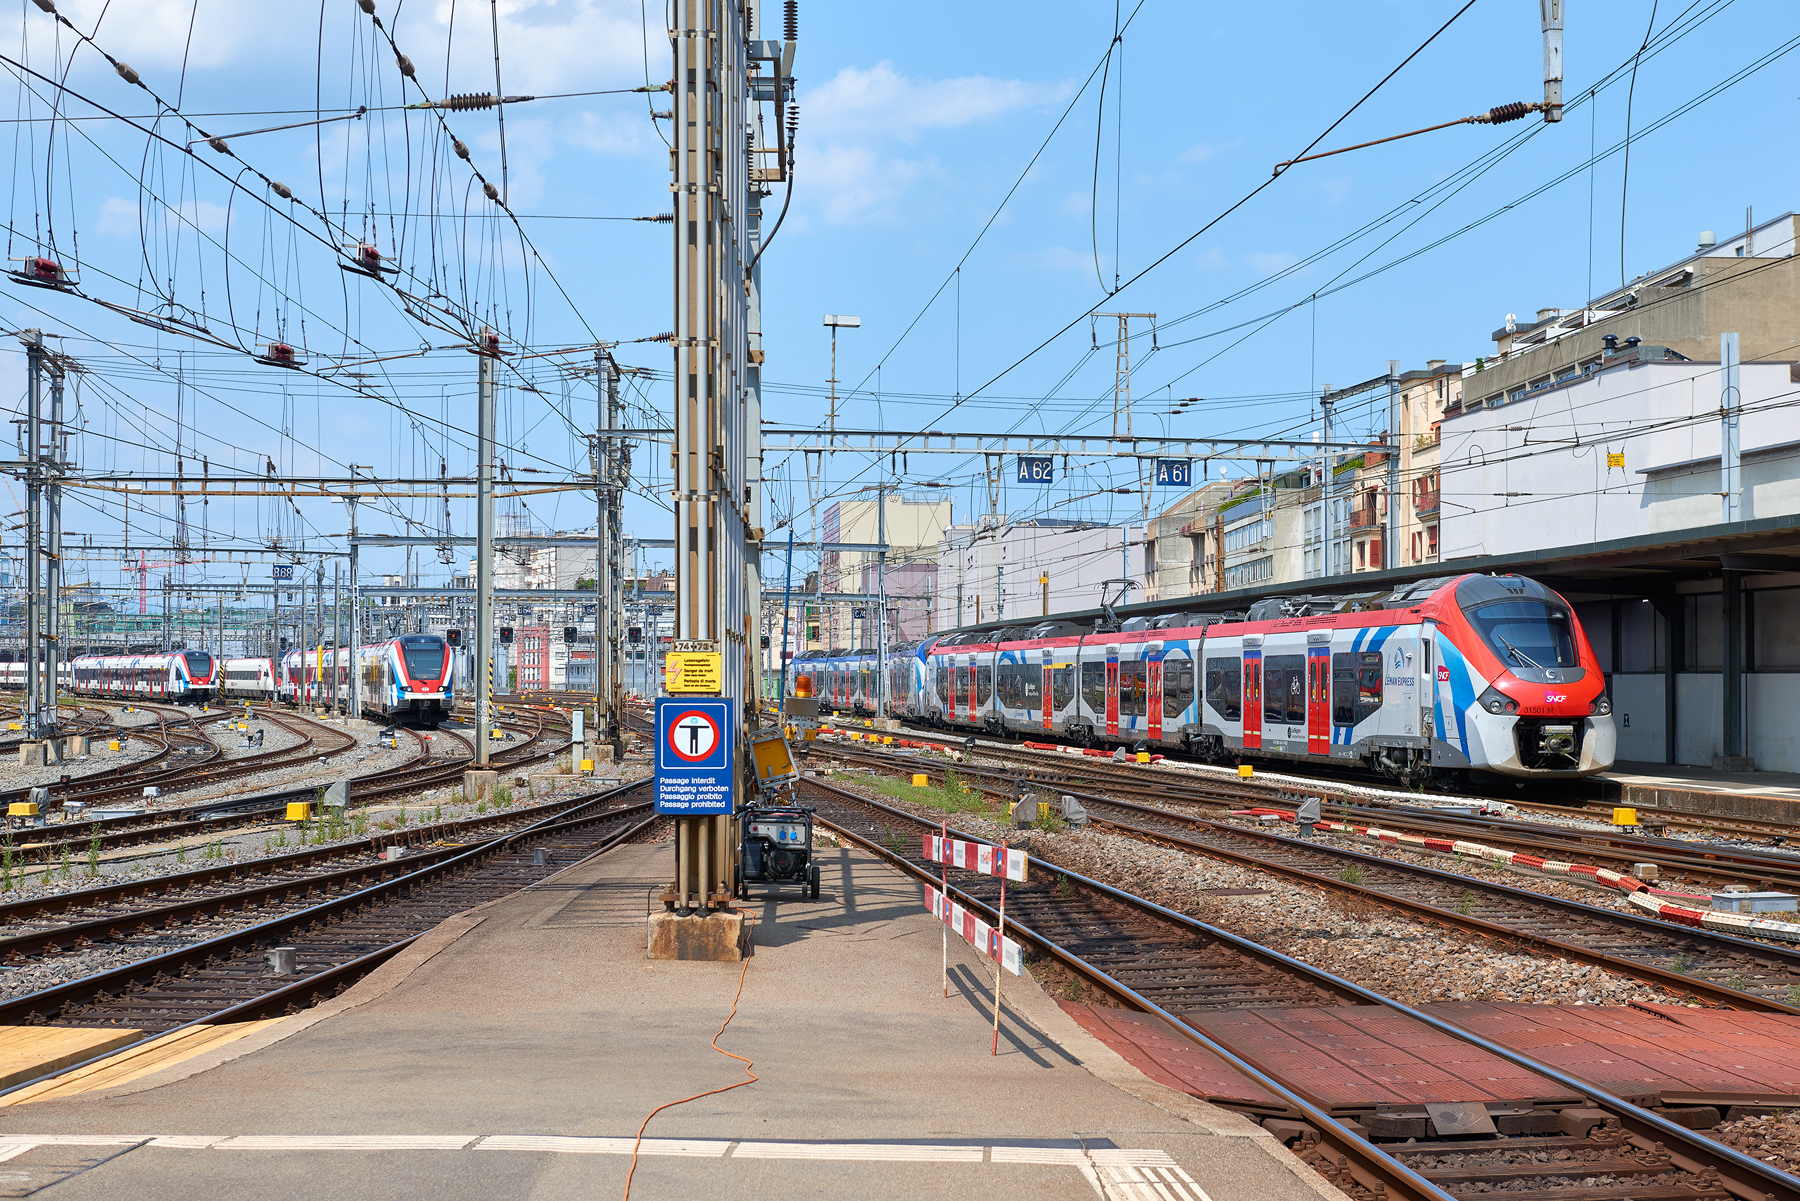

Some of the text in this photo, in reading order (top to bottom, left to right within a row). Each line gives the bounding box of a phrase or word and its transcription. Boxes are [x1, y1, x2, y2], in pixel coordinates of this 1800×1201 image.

[1019, 461, 1052, 480] A 62
[1159, 464, 1189, 483] A 61
[678, 642, 690, 651] 74
[697, 642, 710, 651] 73
[1437, 671, 1450, 680] SNCF
[1397, 676, 1415, 686] EXPRESS
[1546, 695, 1567, 703] SNCF
[659, 777, 690, 785] Passage
[659, 785, 697, 793] Durchgang
[659, 793, 723, 801] Passaggio proibito
[659, 801, 726, 809] Passage prohibited
